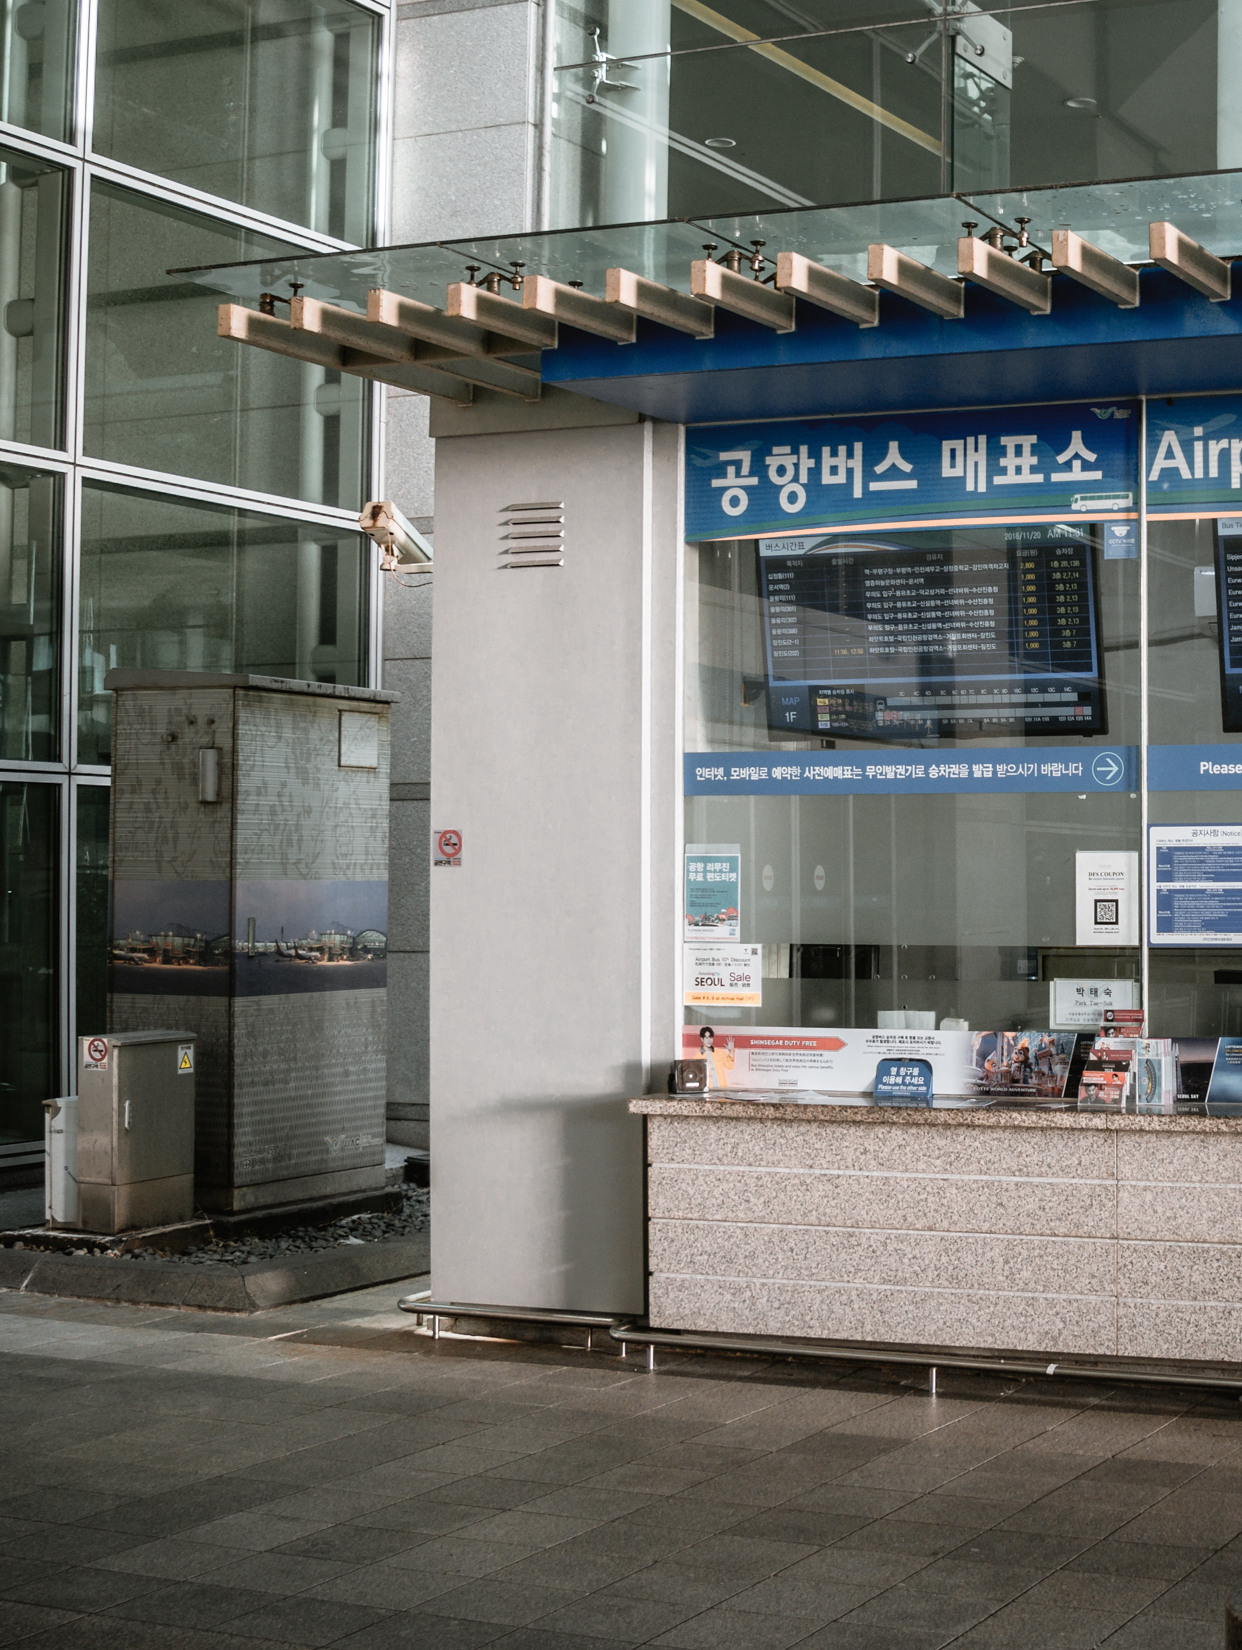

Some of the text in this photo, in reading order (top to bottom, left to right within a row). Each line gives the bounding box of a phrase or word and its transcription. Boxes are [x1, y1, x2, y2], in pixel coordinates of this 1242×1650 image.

[712, 430, 1103, 516] 공항버스 매표소
[1004, 531, 1041, 540] 2018/11/20
[1047, 529, 1060, 538] AM
[765, 541, 805, 551] 버스시간표
[1061, 571, 1079, 579] 2,7,14
[784, 711, 797, 722] 1F
[695, 762, 1083, 782] 인터넷, 모바일로 예약한 사전예매표는 무인발권기로 승차권을 발급 받으시기 바랍니다
[1200, 761, 1242, 774] Please
[1191, 829, 1242, 837] 공지사항 (Notice)
[688, 862, 730, 872] 공항 리무진
[688, 872, 704, 882] 무료
[694, 977, 725, 987] SEOUL
[729, 972, 751, 982] Sale
